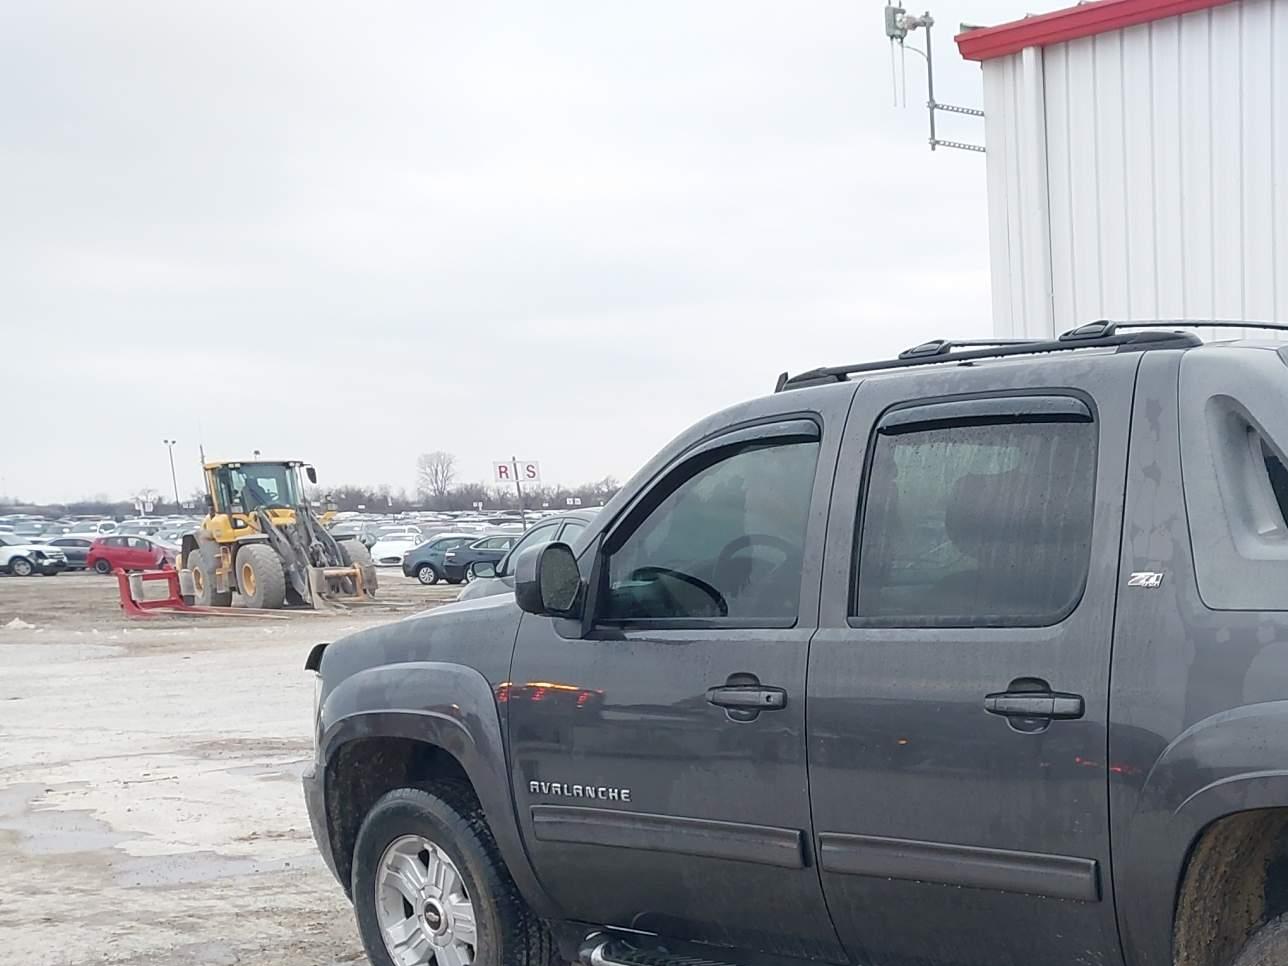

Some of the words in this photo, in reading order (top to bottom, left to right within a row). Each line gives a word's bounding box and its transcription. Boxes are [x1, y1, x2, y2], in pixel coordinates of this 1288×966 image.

[498, 465, 509, 479] R
[526, 464, 536, 479] S
[529, 780, 632, 802] AVALANCHE
